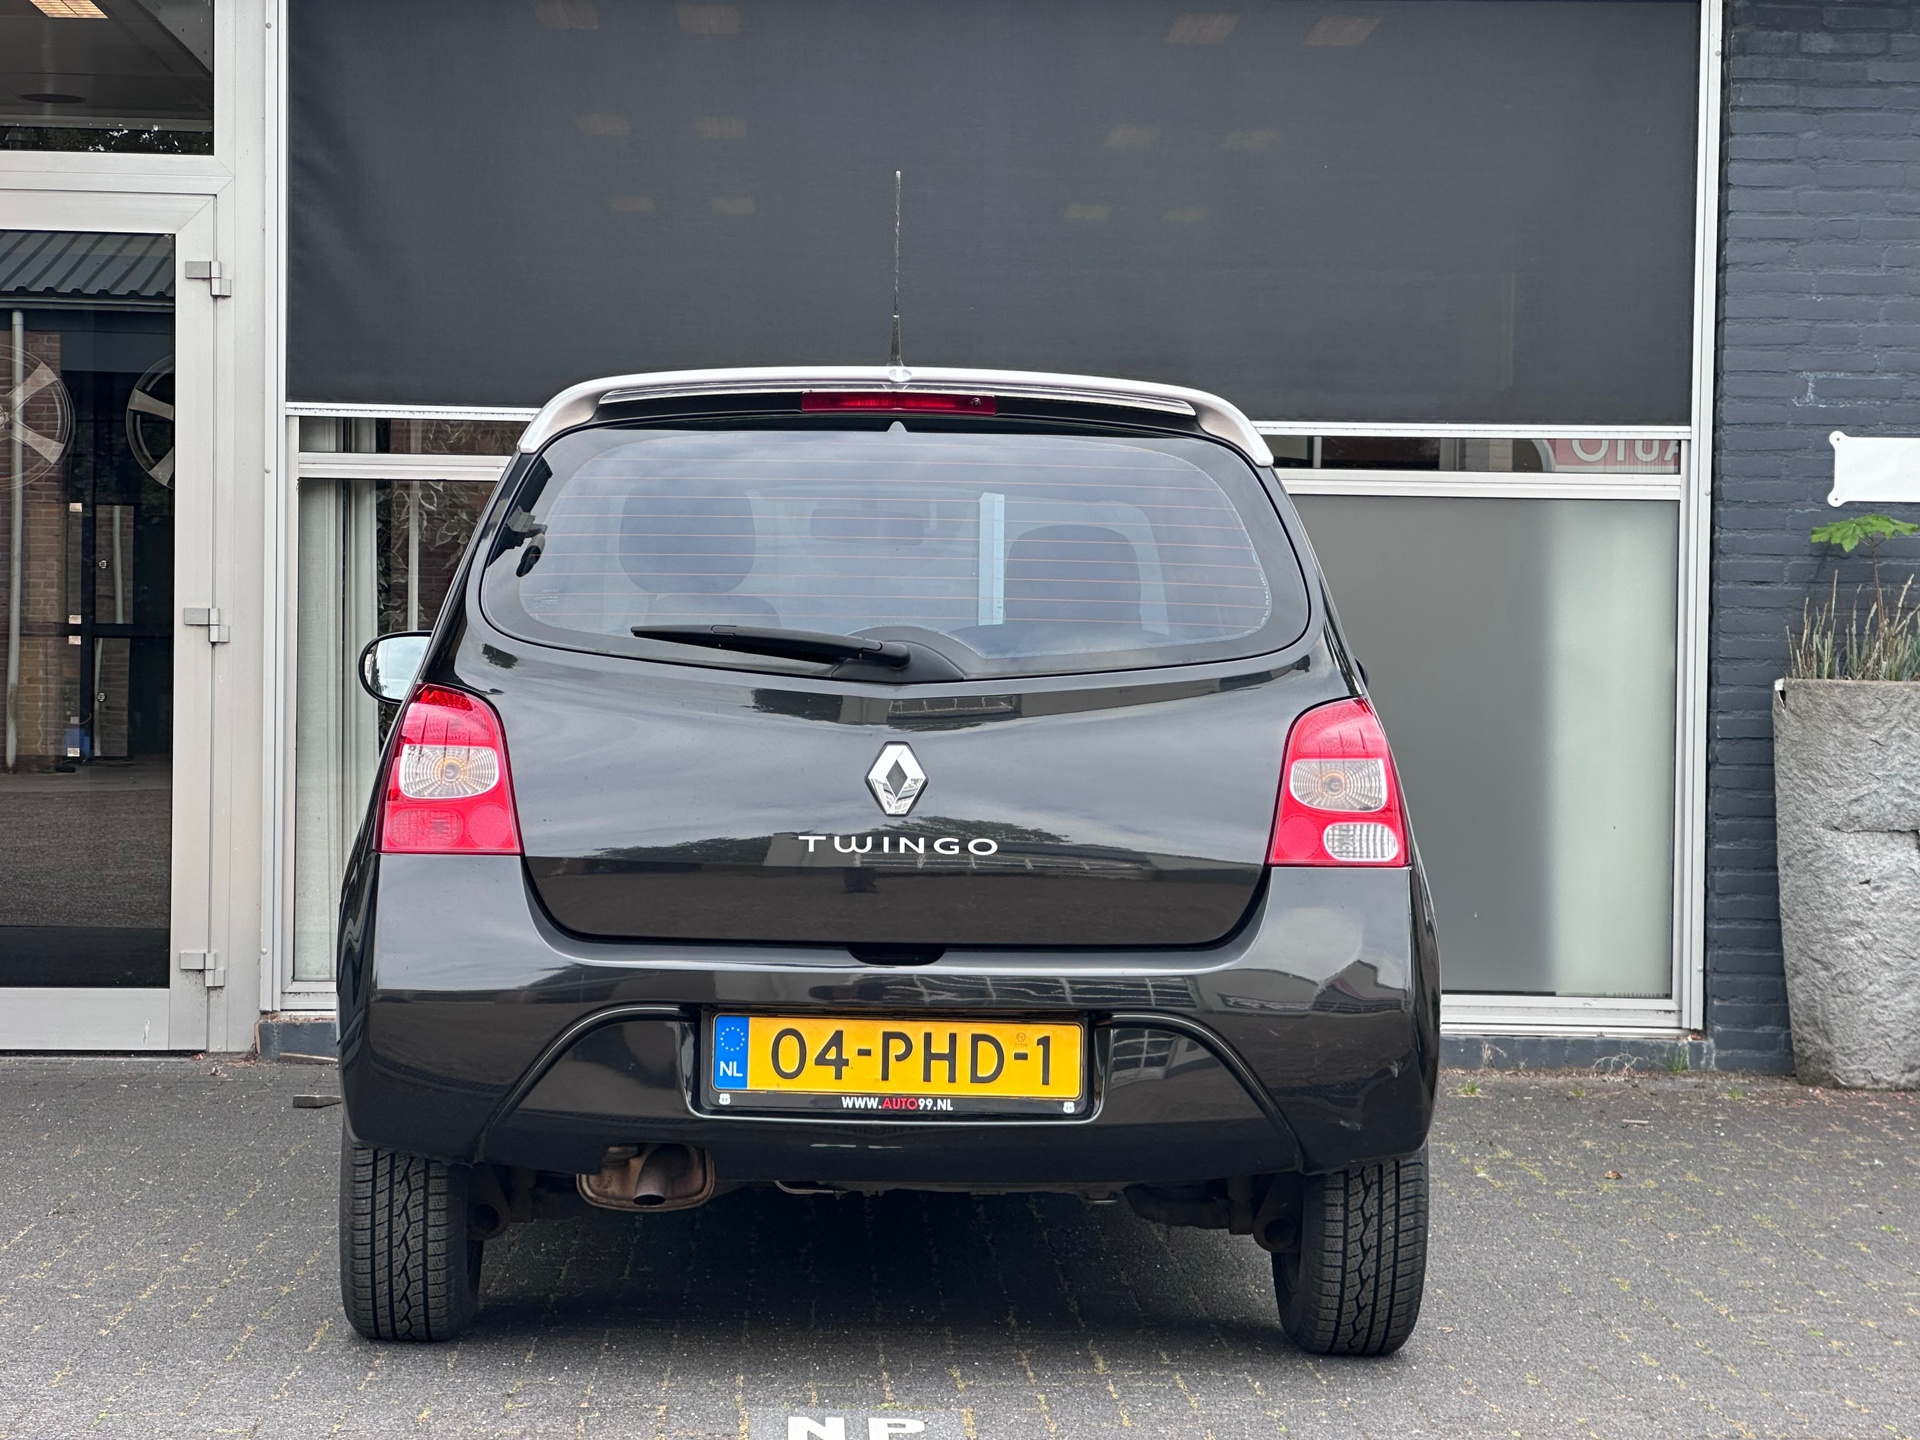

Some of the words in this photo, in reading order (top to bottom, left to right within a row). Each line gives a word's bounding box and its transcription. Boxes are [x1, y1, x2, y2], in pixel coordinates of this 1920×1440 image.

[798, 835, 998, 855] TWINGO
[770, 1027, 1051, 1086] 04-PHD-1
[719, 1060, 744, 1077] NL
[841, 1096, 954, 1111] WWW.AUTO99.NL
